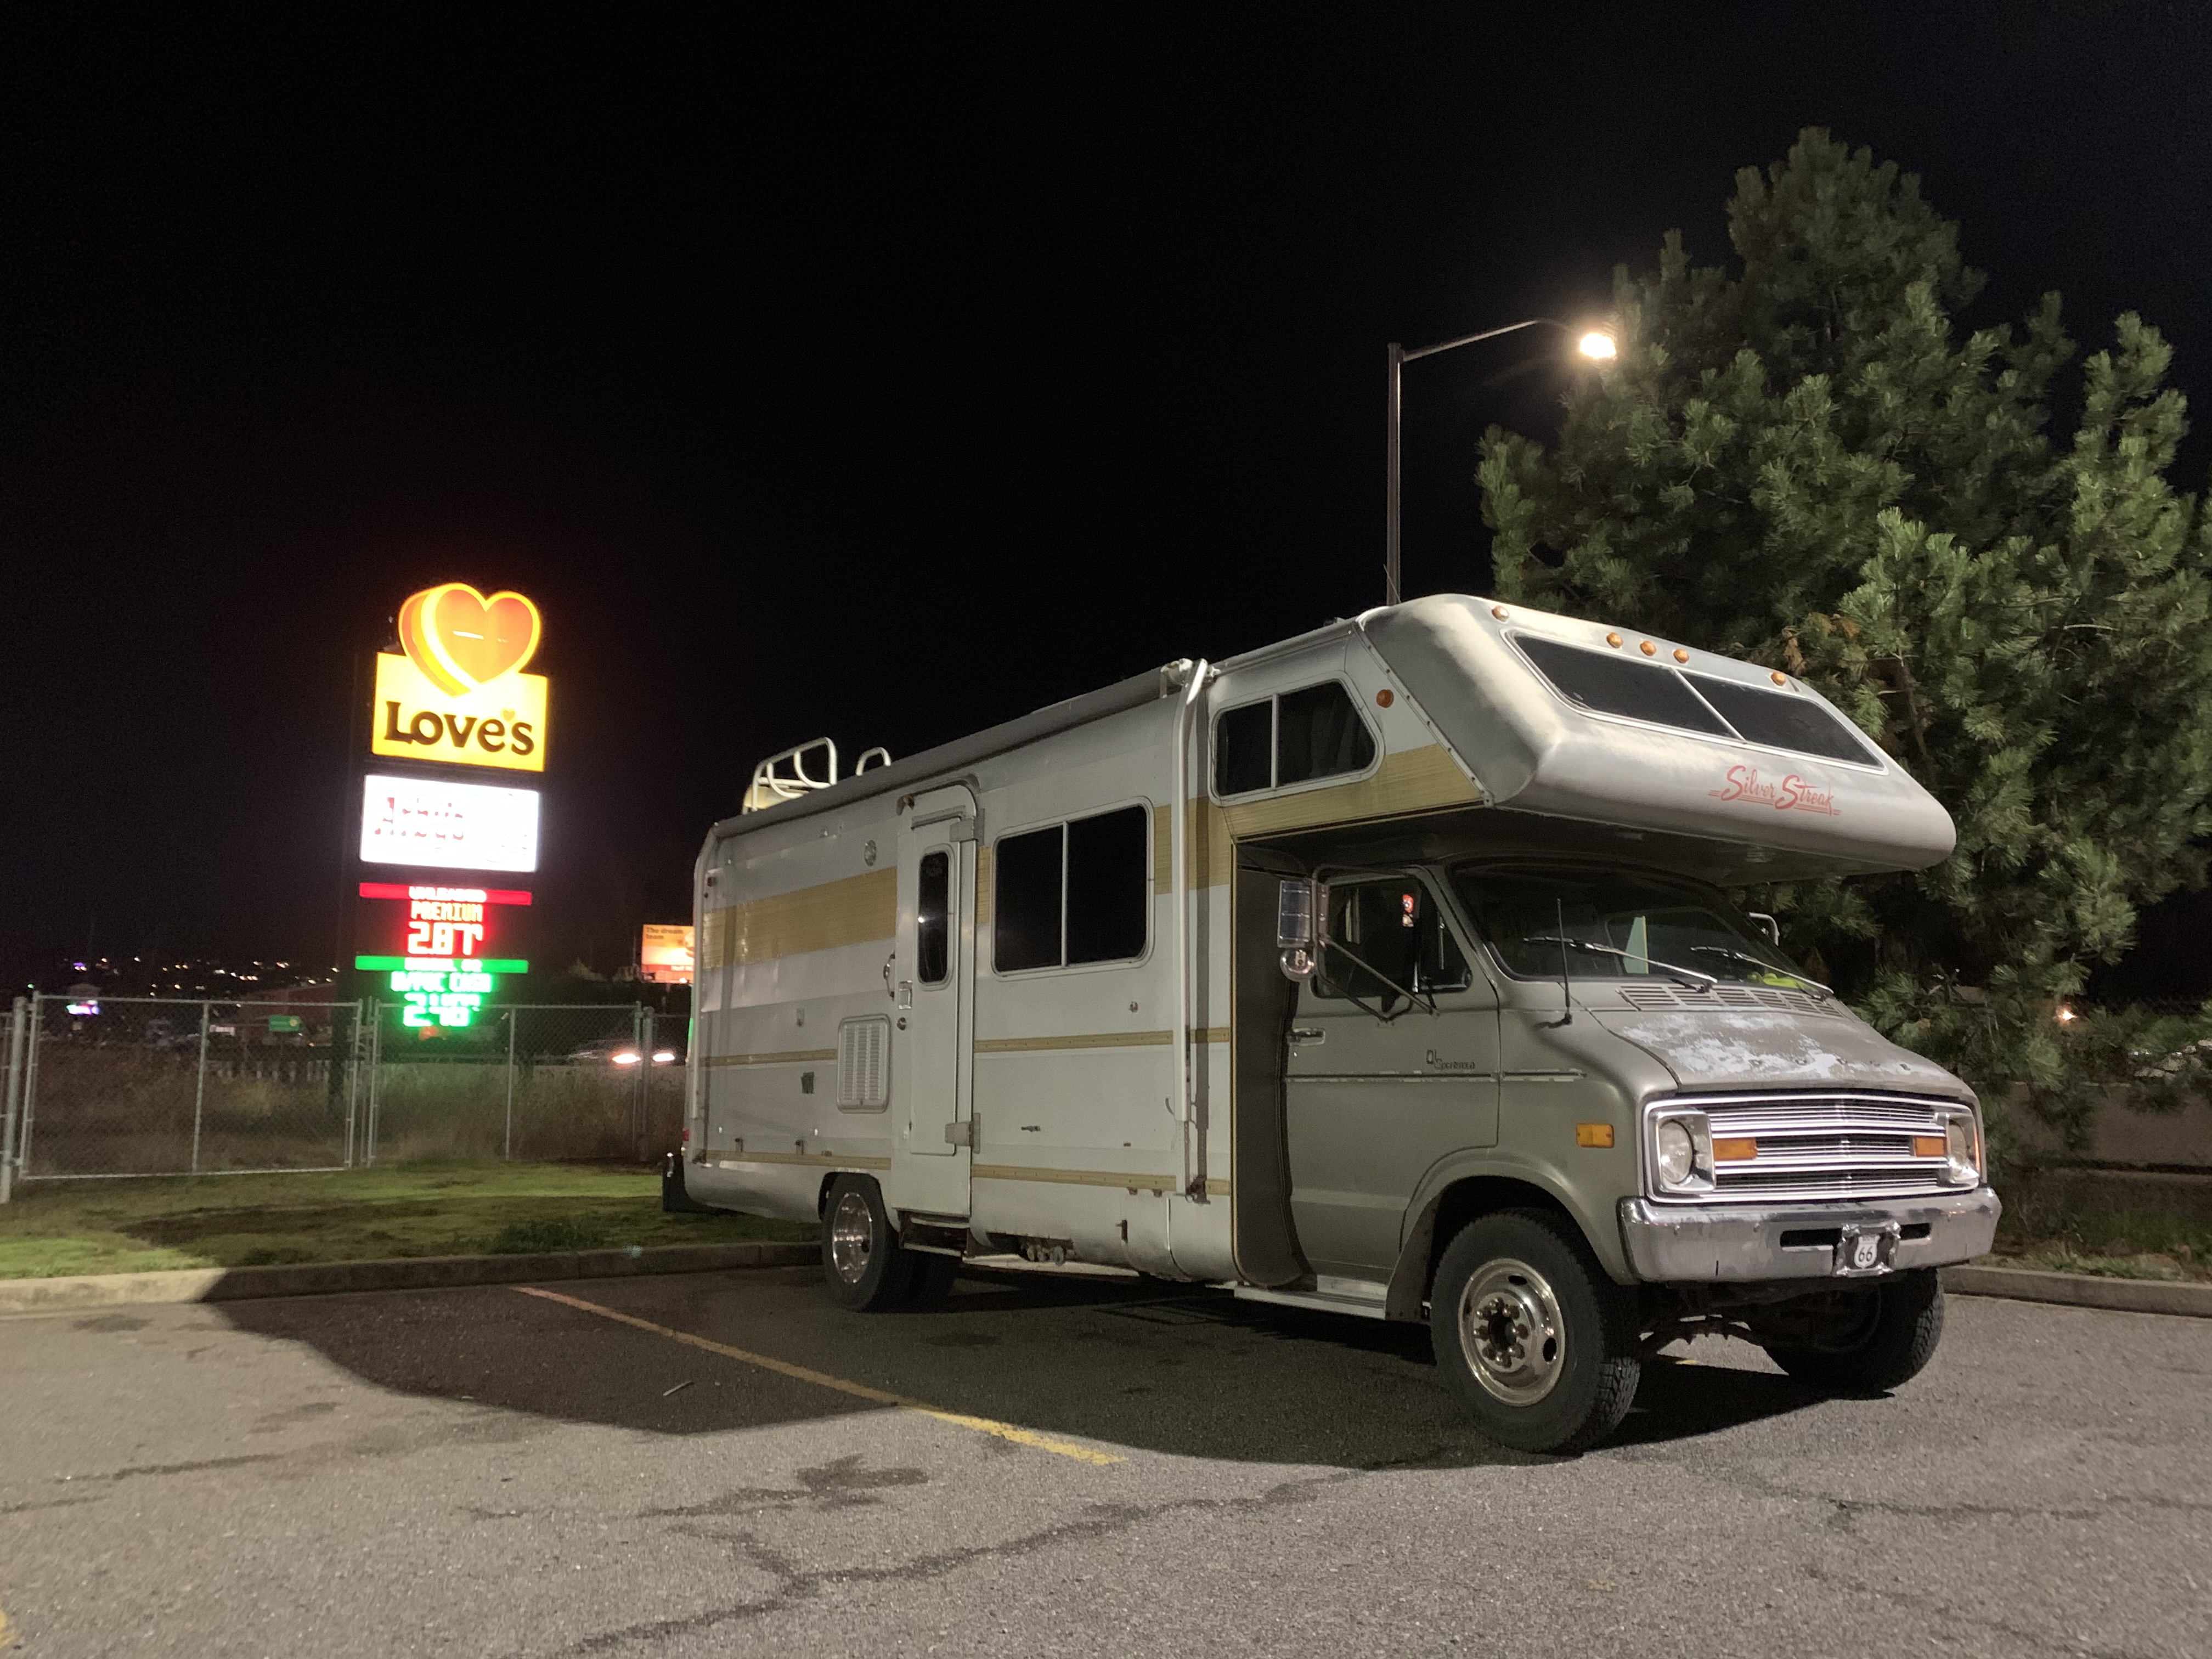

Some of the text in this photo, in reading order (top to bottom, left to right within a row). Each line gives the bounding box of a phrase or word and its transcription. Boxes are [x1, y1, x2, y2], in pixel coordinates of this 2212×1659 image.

[1720, 765, 1835, 817] Silver Streak
[411, 901, 483, 922] PREMIUM
[1858, 1246, 1873, 1262] 66
